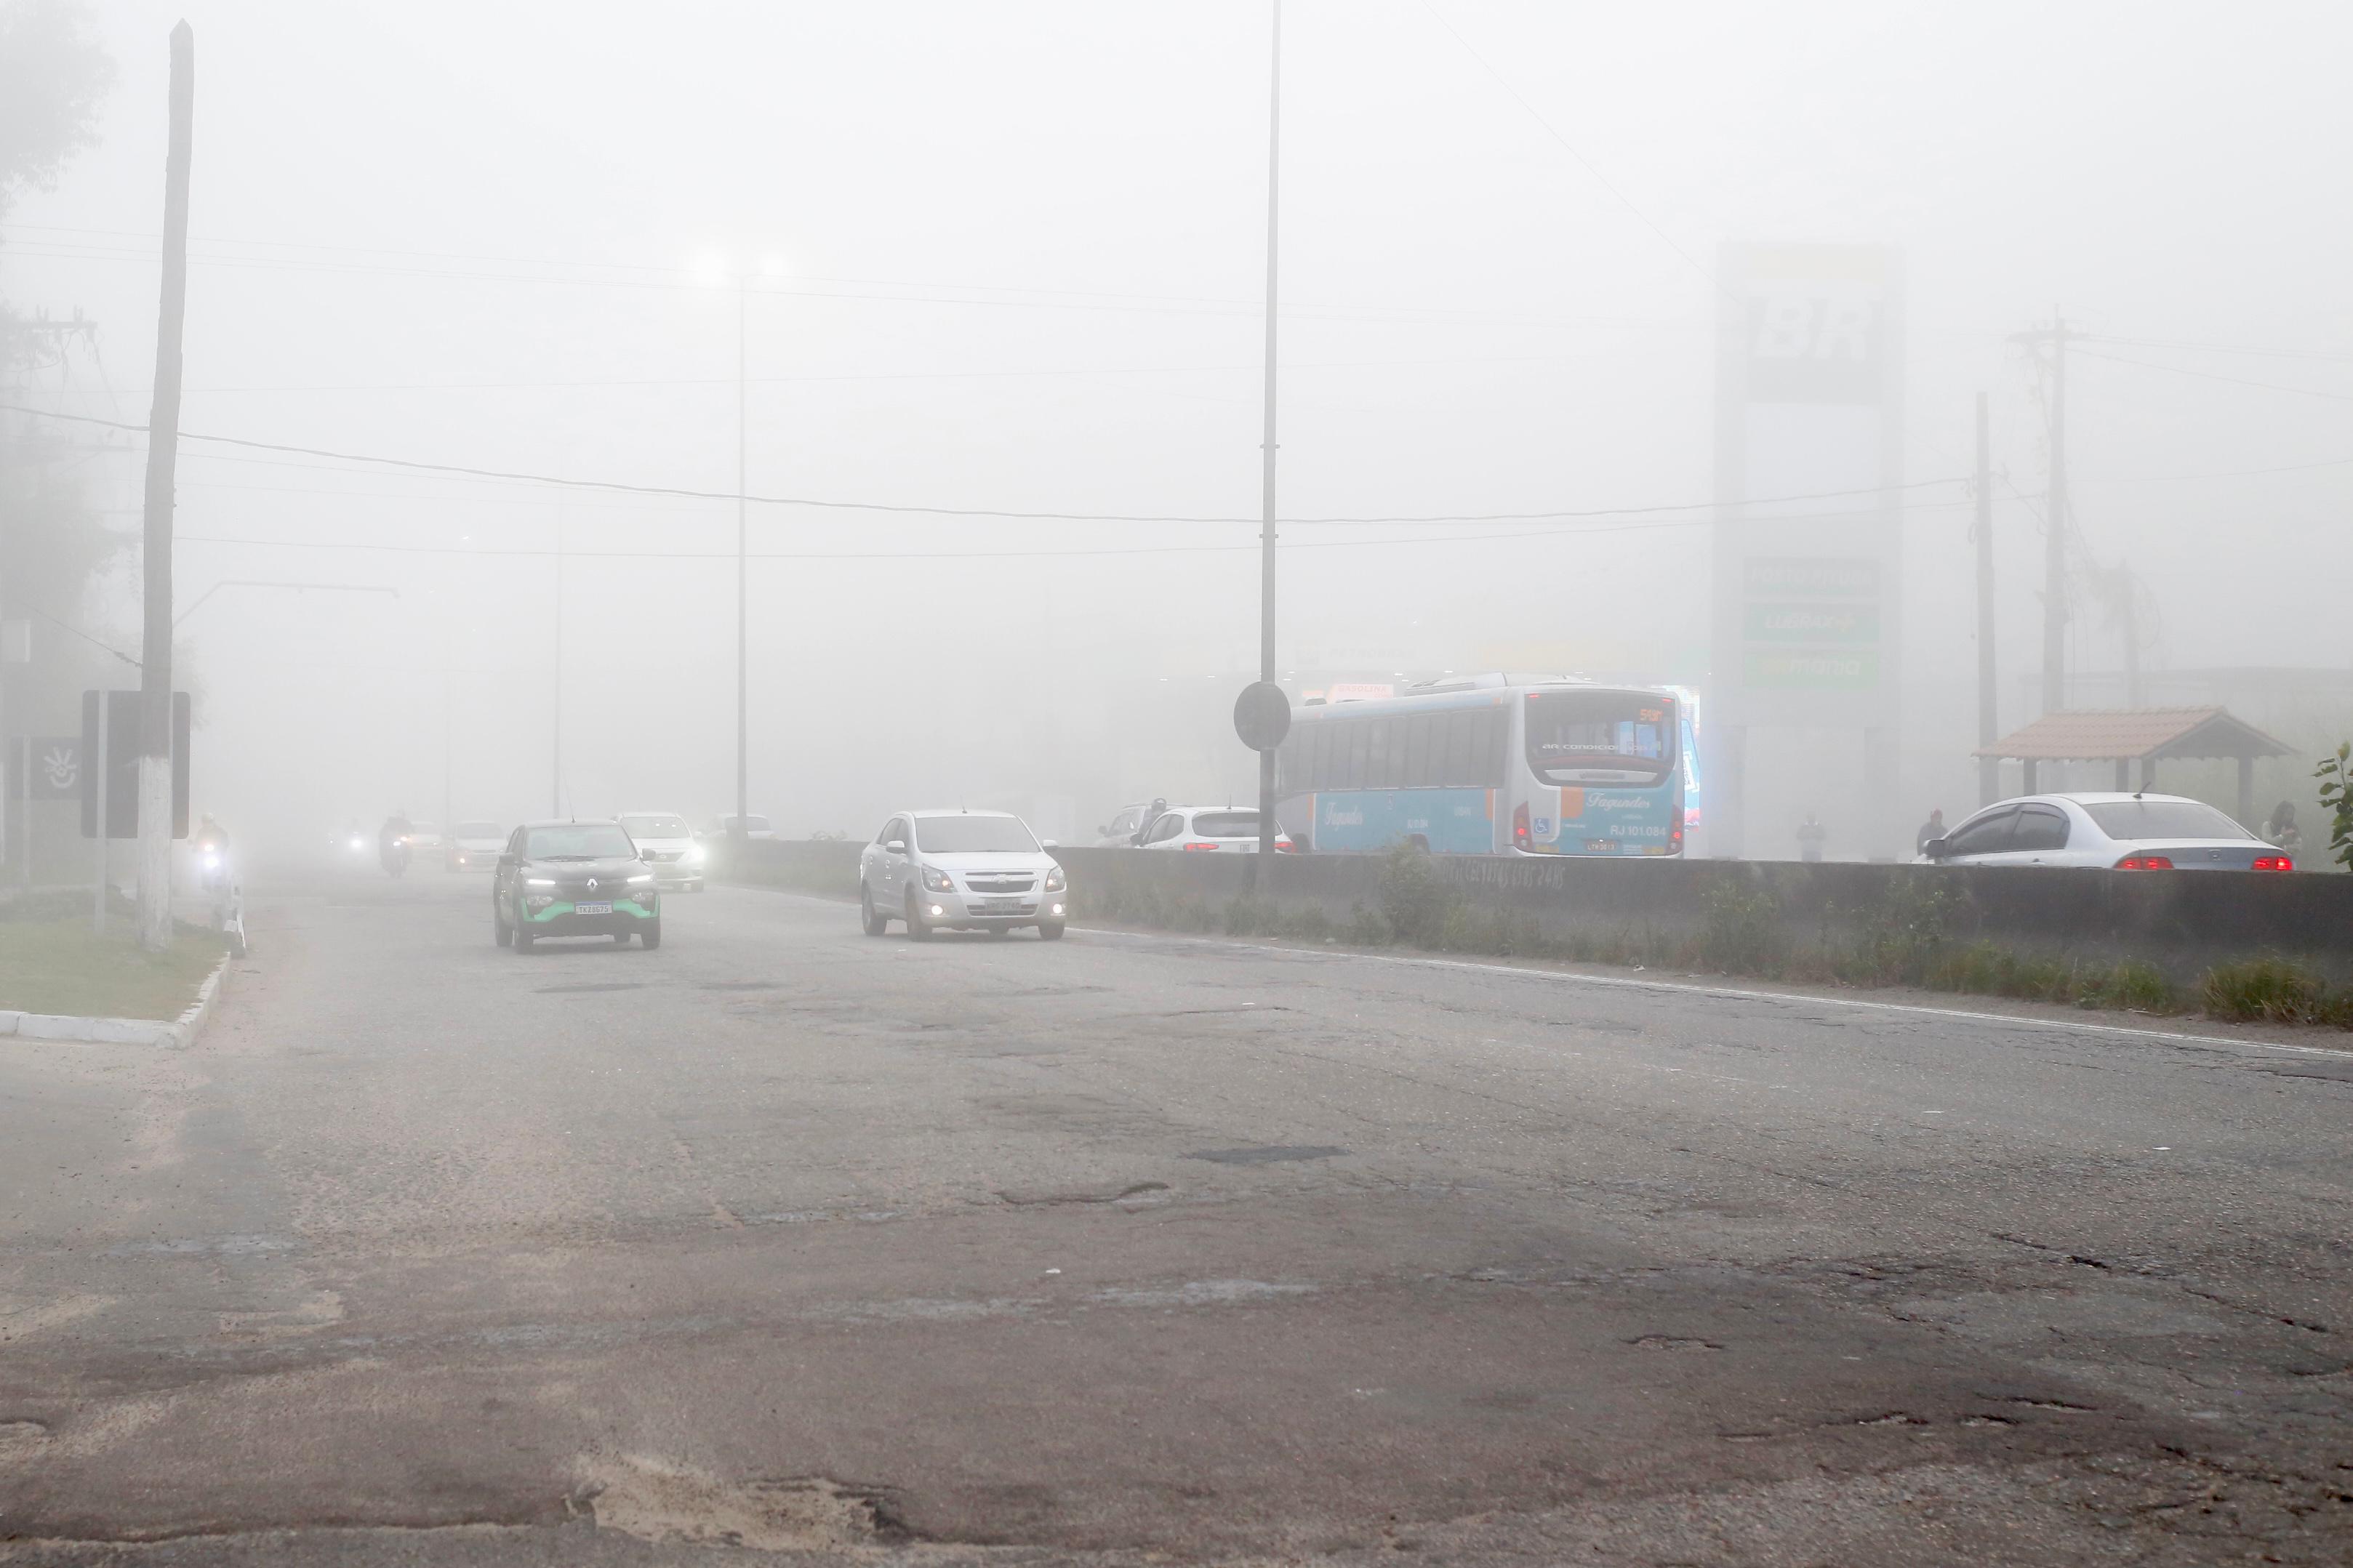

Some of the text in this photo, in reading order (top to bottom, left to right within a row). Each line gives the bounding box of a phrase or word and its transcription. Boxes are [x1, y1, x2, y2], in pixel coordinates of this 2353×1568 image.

[1753, 294, 1874, 361] BR
[1587, 792, 1651, 811] Fagundes
[1610, 825, 1624, 836] RJ
